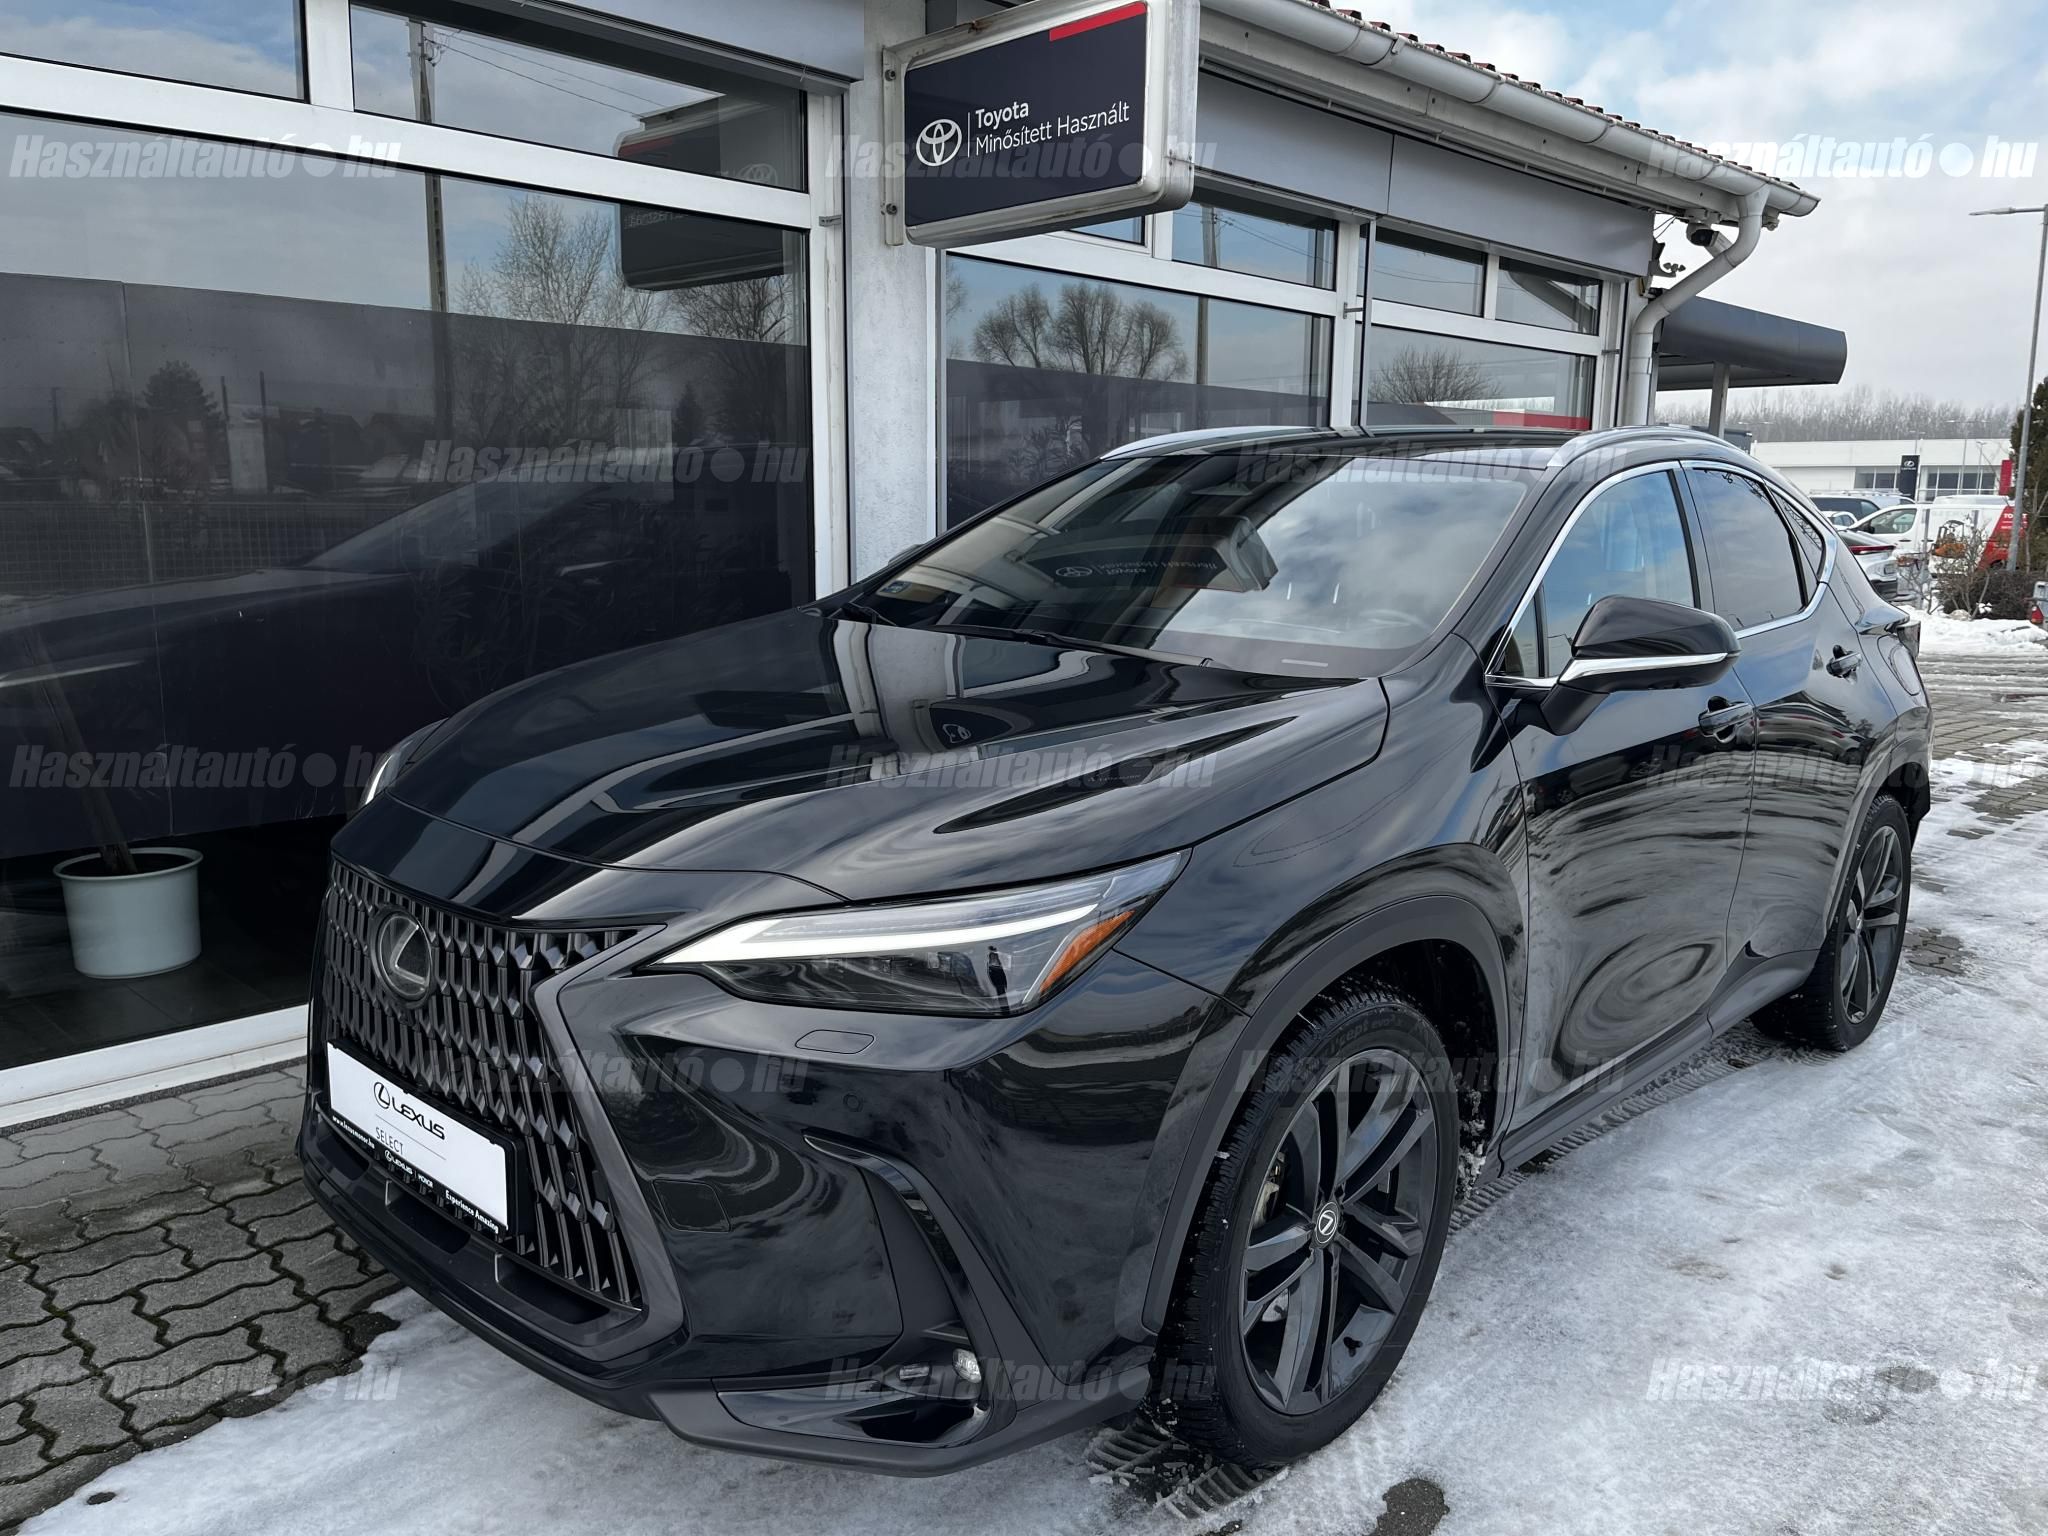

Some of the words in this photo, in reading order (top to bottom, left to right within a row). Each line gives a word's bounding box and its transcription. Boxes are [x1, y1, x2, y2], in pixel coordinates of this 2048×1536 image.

[975, 101, 1029, 129] Toyota
[975, 121, 1052, 156] Minősített
[1057, 100, 1130, 137] Használt
[391, 1096, 446, 1140] LEXUS
[375, 1126, 404, 1156] SELECT
[445, 1189, 475, 1216] Experience
[475, 1209, 499, 1234] Amazing
